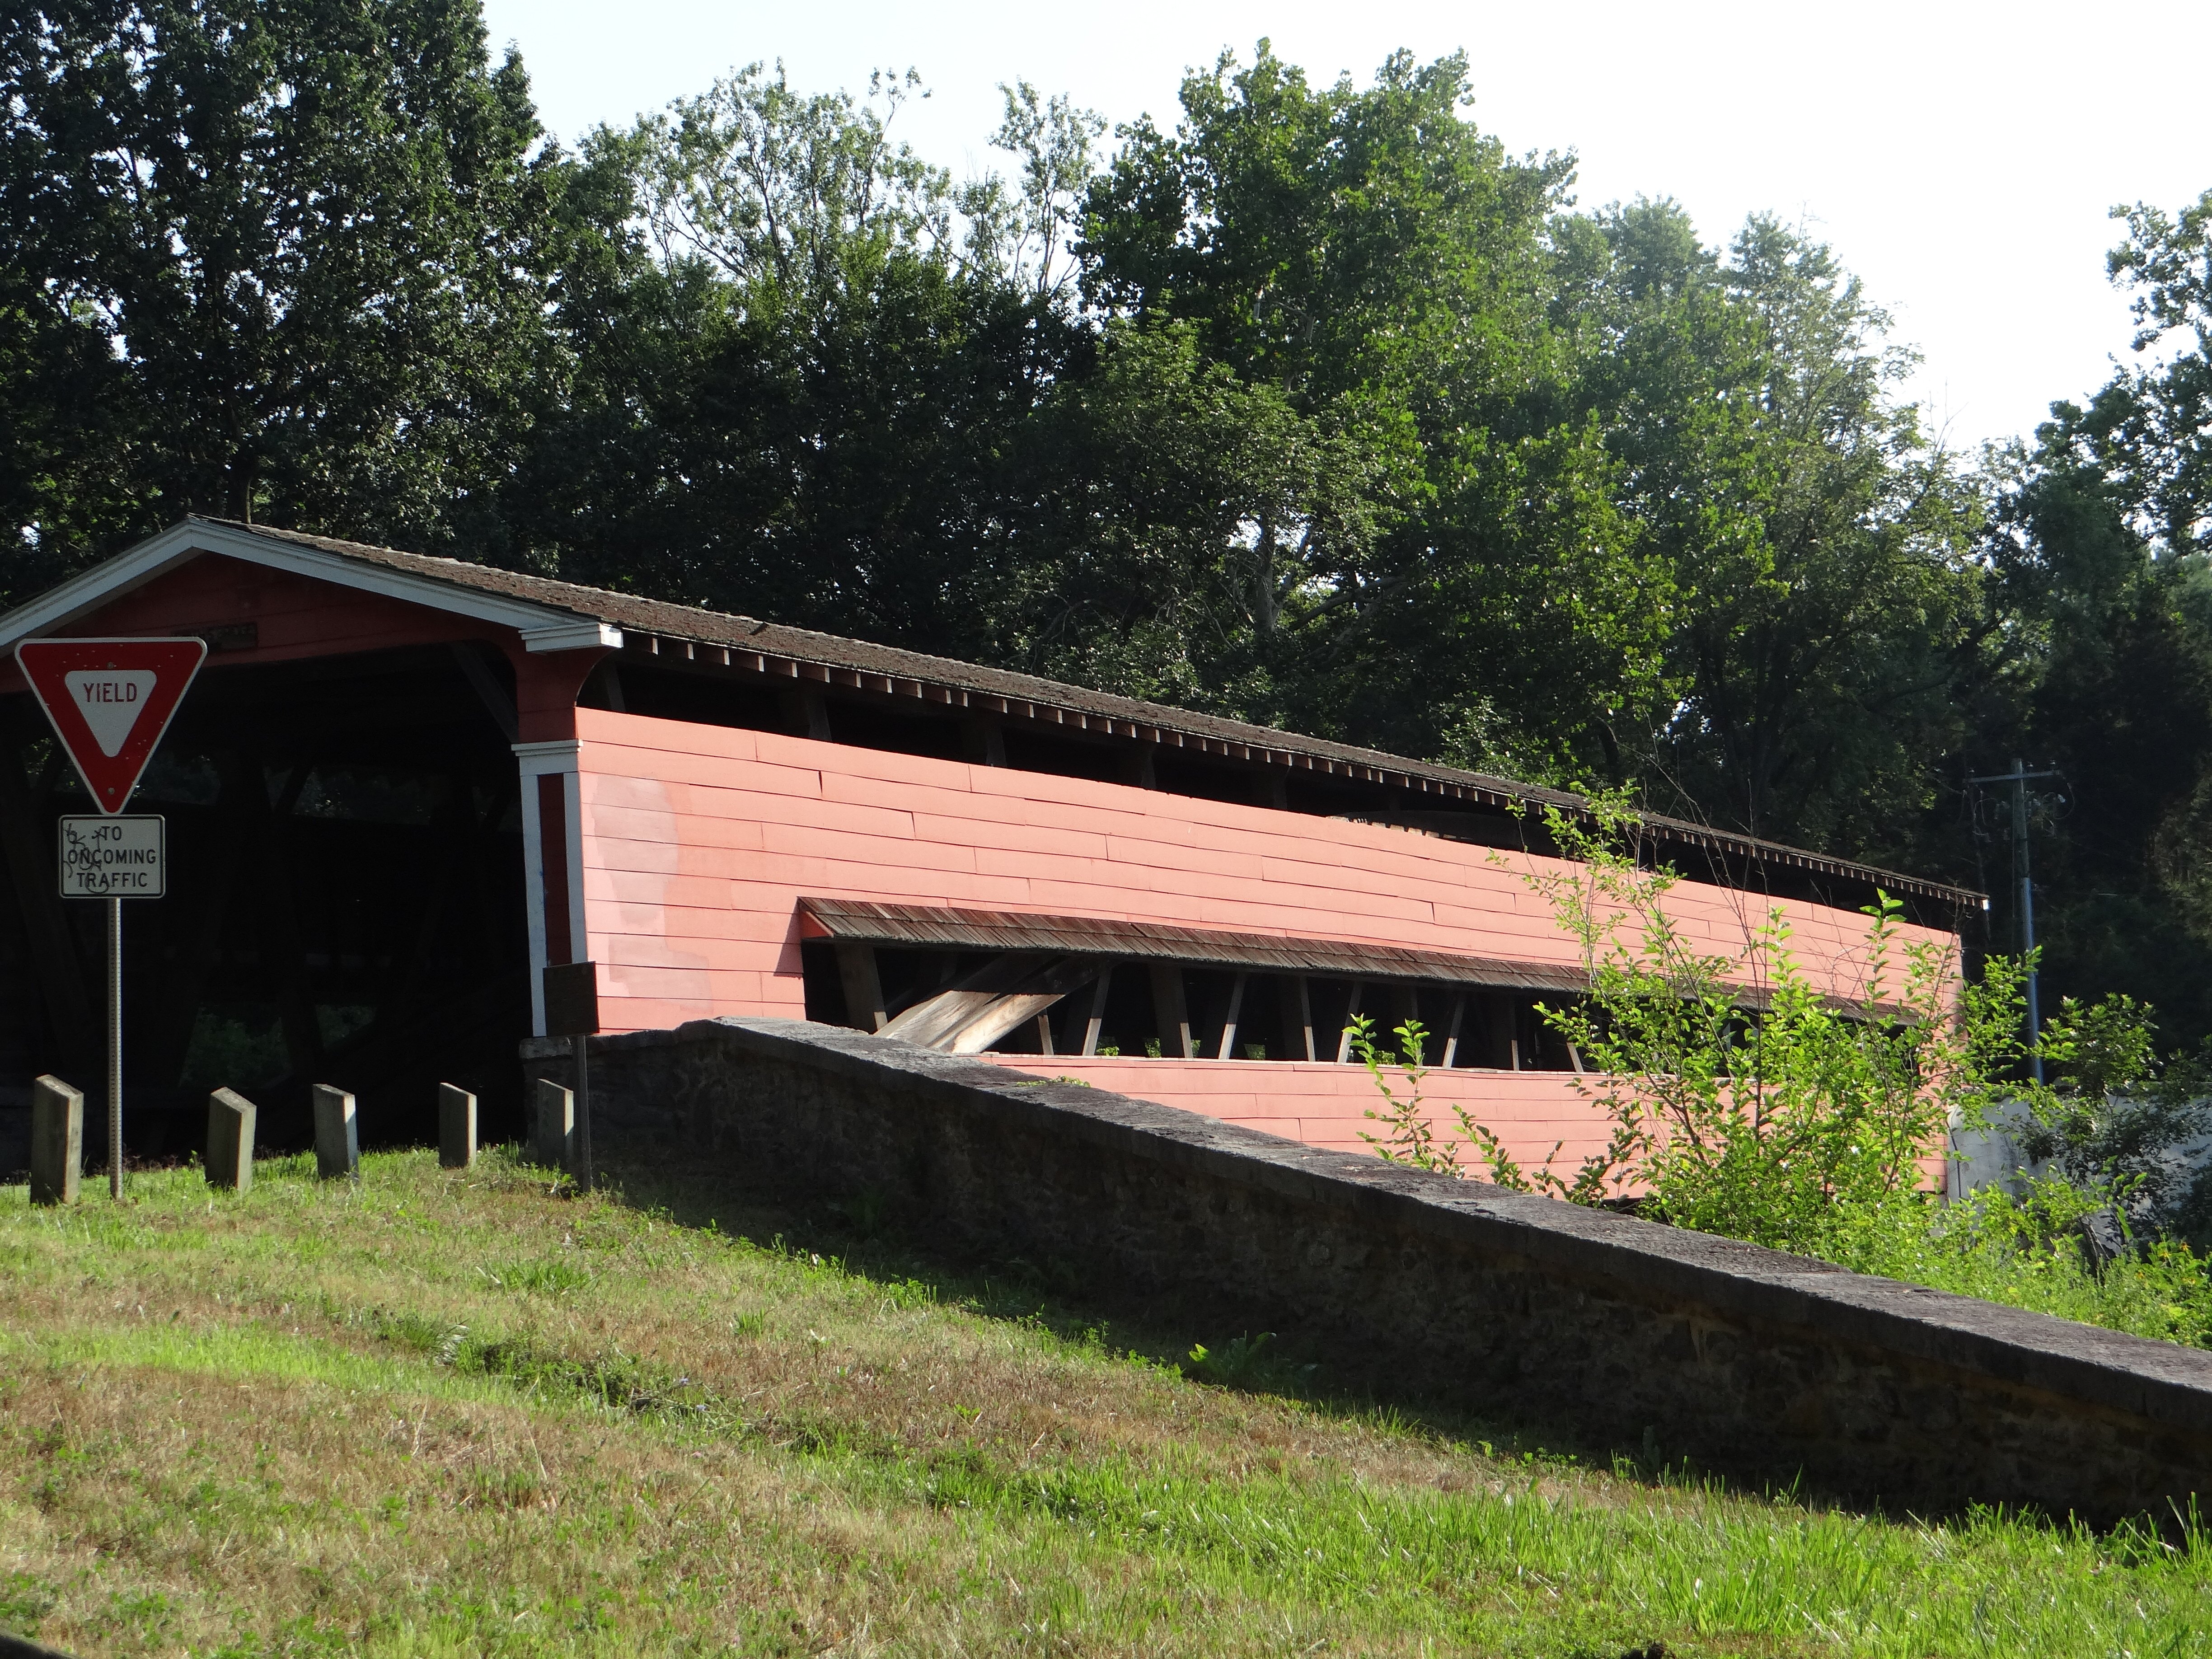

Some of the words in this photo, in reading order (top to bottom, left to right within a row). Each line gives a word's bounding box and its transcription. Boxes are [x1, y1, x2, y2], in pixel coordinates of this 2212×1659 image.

[83, 683, 137, 702] YIELD
[101, 826, 122, 840] TO
[68, 849, 156, 864] ONCOMING
[77, 872, 147, 887] TRAFFIC
